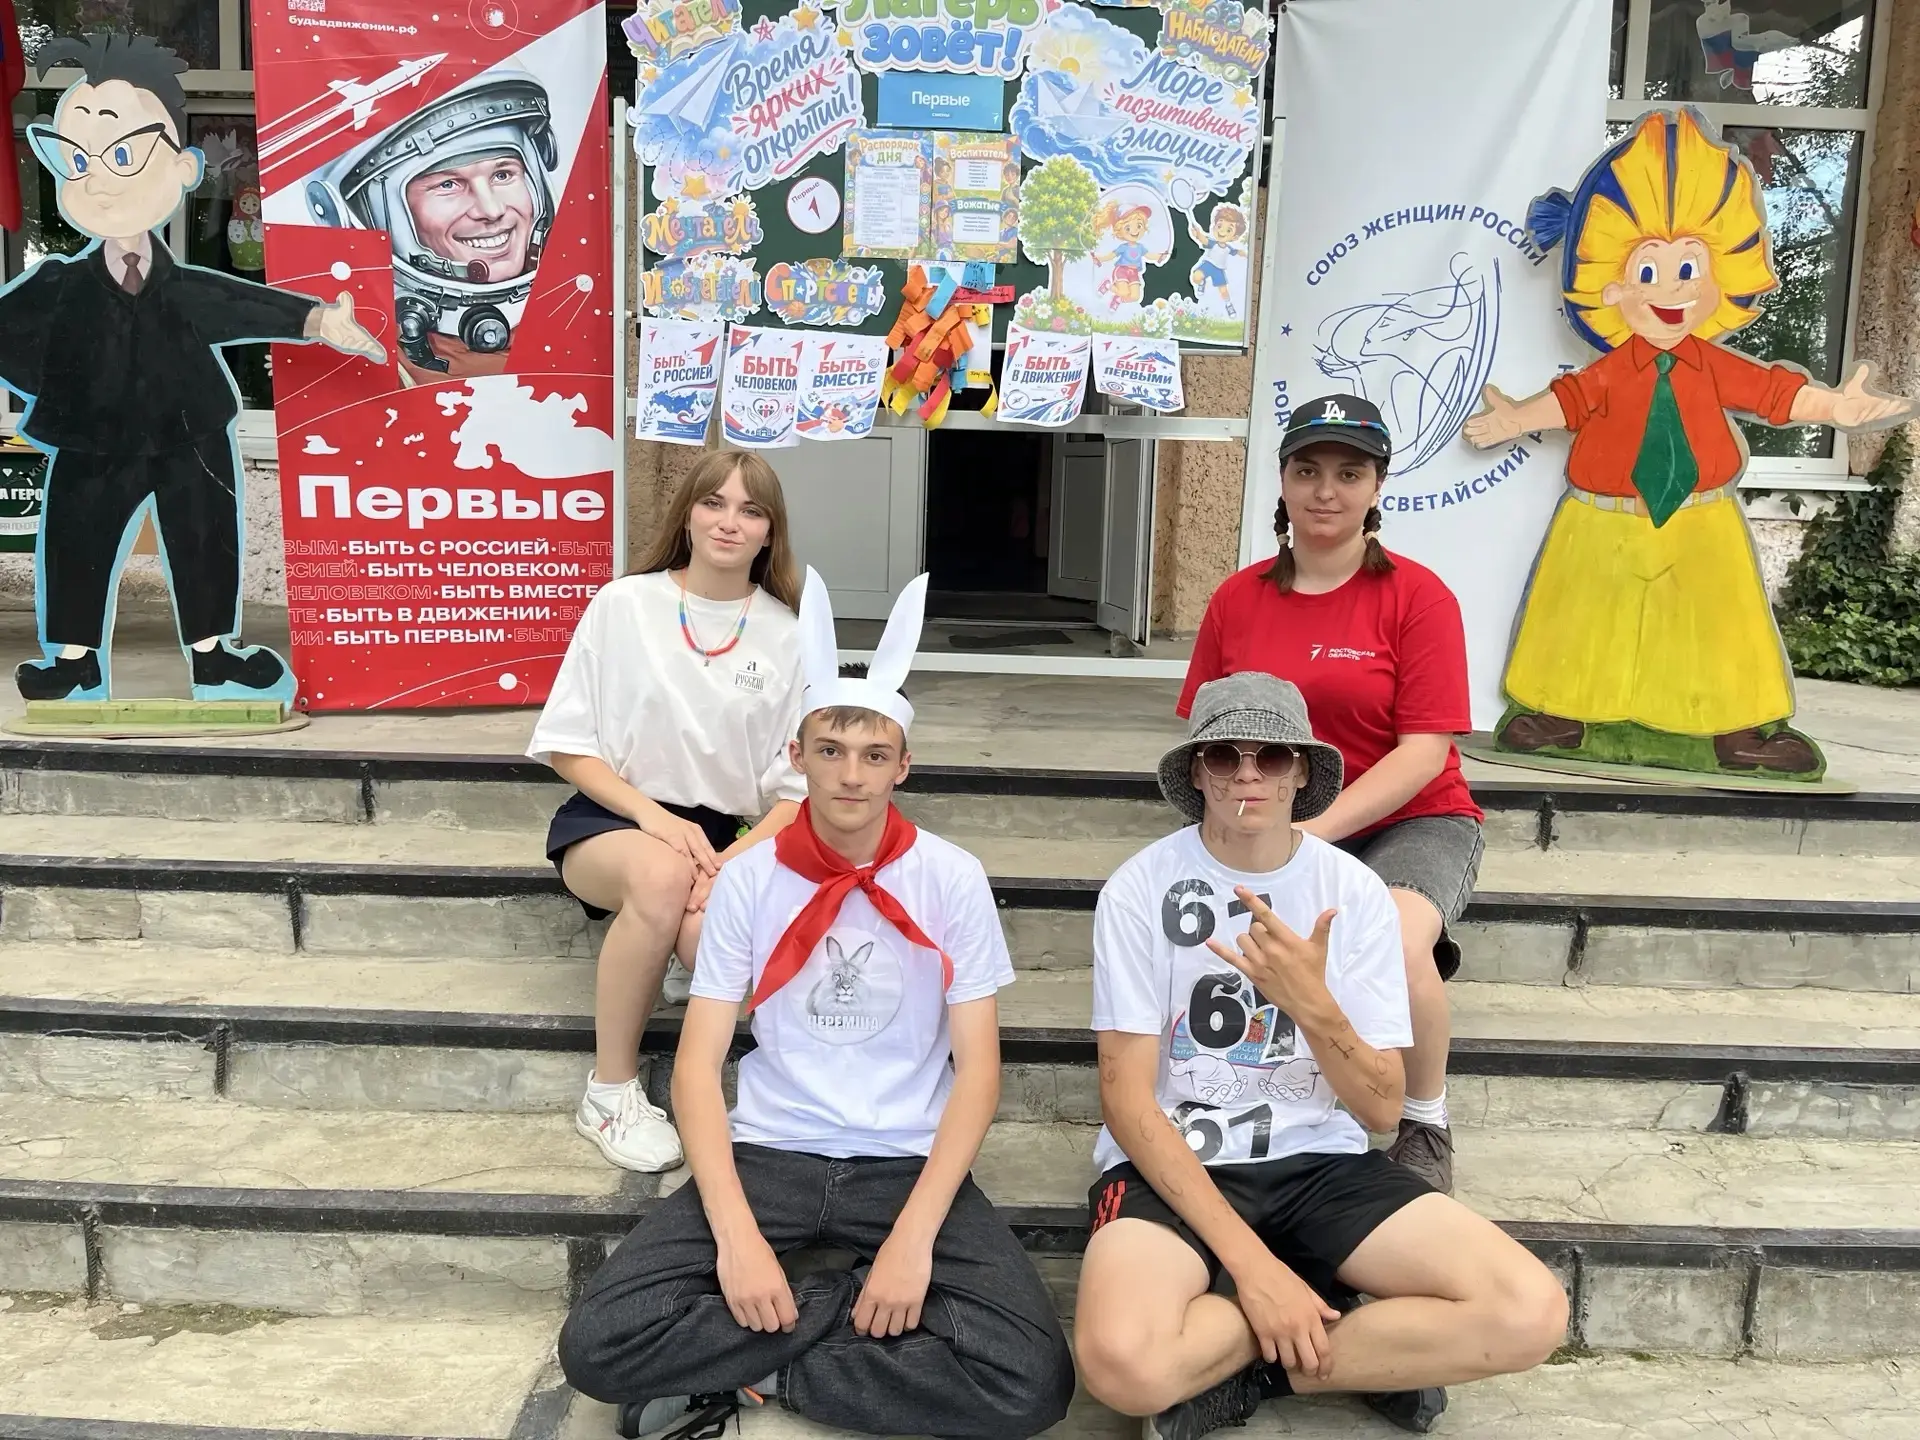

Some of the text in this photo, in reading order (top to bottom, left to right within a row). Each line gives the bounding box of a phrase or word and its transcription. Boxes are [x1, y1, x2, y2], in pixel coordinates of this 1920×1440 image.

[289, 15, 418, 35] будьвдвижении.рф
[724, 35, 829, 111] Время
[1120, 52, 1223, 105] Море
[749, 63, 837, 137] ярких
[912, 91, 970, 109] Первые
[744, 72, 857, 173] открытий!
[1115, 94, 1249, 143] позитивных
[859, 139, 919, 153] Распорядок
[1116, 126, 1242, 173] эмоций!
[791, 181, 820, 203] Первые
[957, 200, 1000, 210] Вожатые
[1306, 204, 1548, 286] СОЮЗ ЖЕНЩИН РОССИИ
[654, 355, 685, 369] БЫТЬ
[743, 355, 797, 377] БЫТЬ
[819, 360, 866, 373] БЫТЬ
[1025, 356, 1071, 370] БЫТЬ
[1115, 360, 1157, 373] БЫТЬ
[653, 364, 713, 383] С РОССИЕЙ
[813, 371, 877, 388] ВМЕСТЕ
[1012, 370, 1082, 384] В ДВИЖЕНИИ
[1104, 367, 1173, 384] ПЕРВЫМИ
[1321, 401, 1346, 421] LA
[1381, 444, 1531, 511] СВЕТАЙСКИЙ
[299, 475, 605, 529] Первые
[348, 540, 414, 555] БЫТЬ
[419, 540, 435, 555] С
[440, 537, 549, 555] РОССИЕЙ
[368, 563, 433, 577] БЫТЬ
[438, 563, 579, 577] ЧЕЛОВЕКОМ
[441, 585, 504, 599] БЫТЬ
[509, 585, 599, 599] ВМЕСТЕ
[327, 608, 392, 622] БЫТЬ
[398, 607, 412, 621] В
[418, 606, 550, 624] ДВИЖЕНИИ
[334, 629, 399, 645] БЫТЬ
[405, 629, 504, 644] ПЕРВЫМ
[1328, 647, 1376, 658] РОСТОВСКАЯ
[1328, 653, 1360, 661] ОБЛАСТЬ
